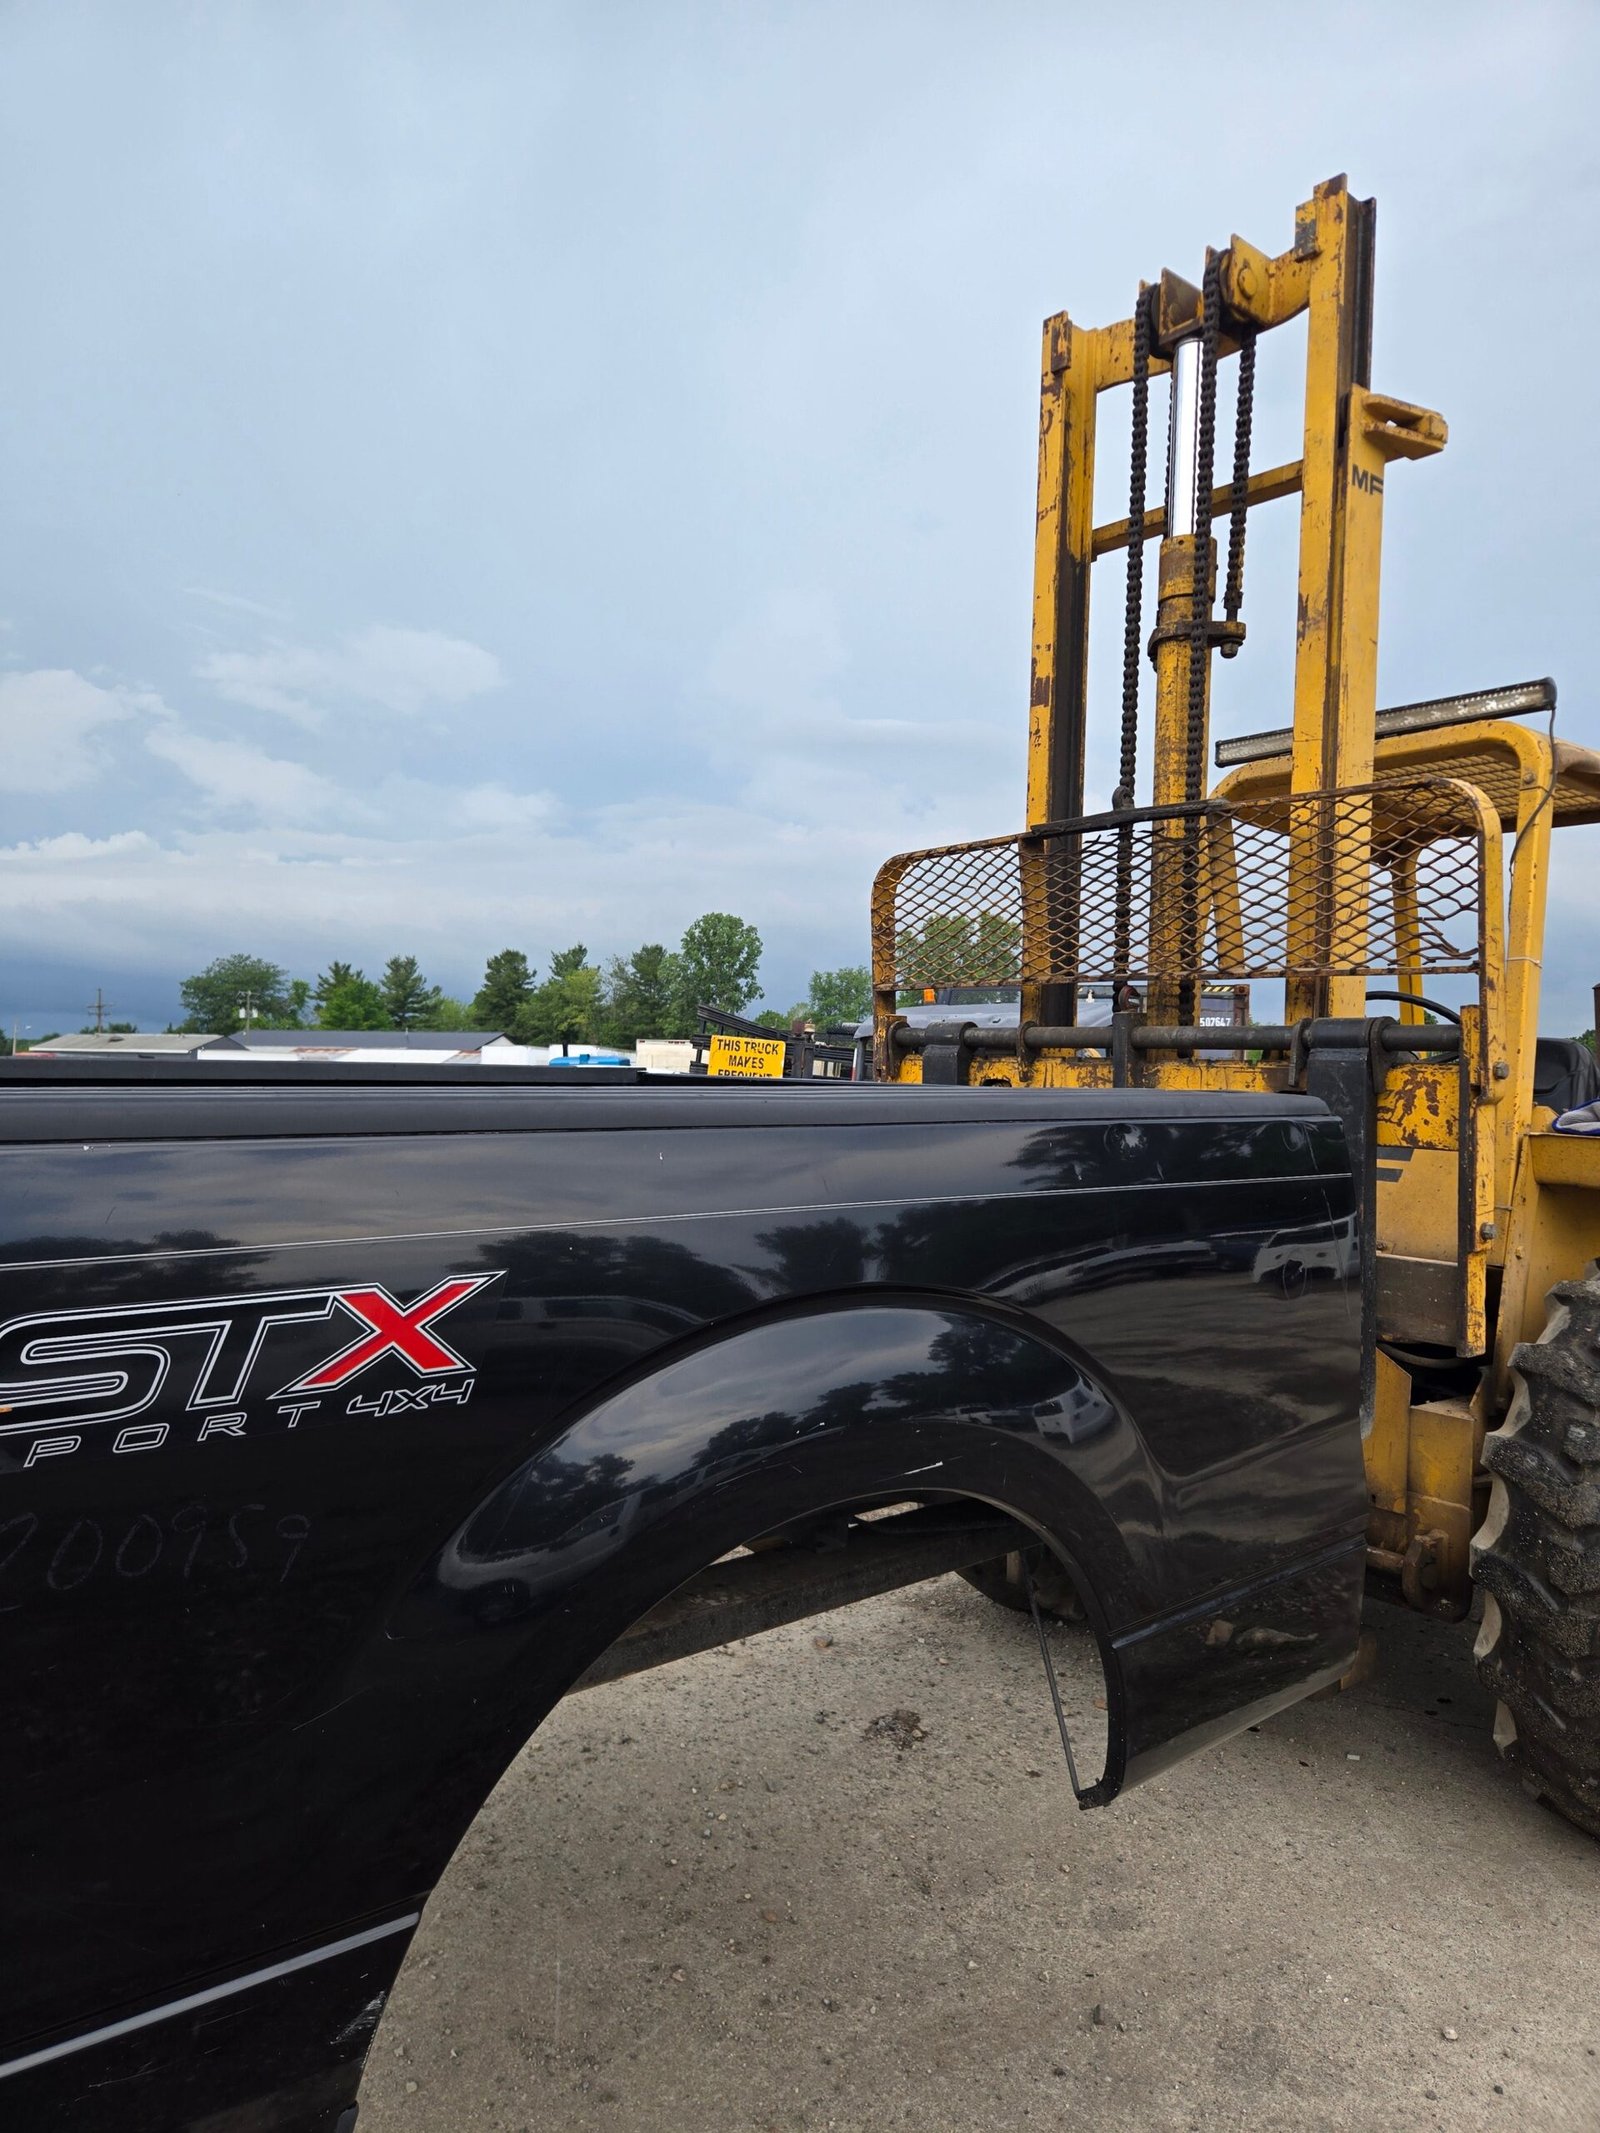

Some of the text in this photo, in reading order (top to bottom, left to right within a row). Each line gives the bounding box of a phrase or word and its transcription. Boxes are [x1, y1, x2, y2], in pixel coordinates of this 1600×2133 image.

[717, 1039, 779, 1056] THIS TRUCK
[728, 1054, 765, 1070] MAKES
[0, 1269, 508, 1437] STX
[346, 1378, 476, 1417] 4X4
